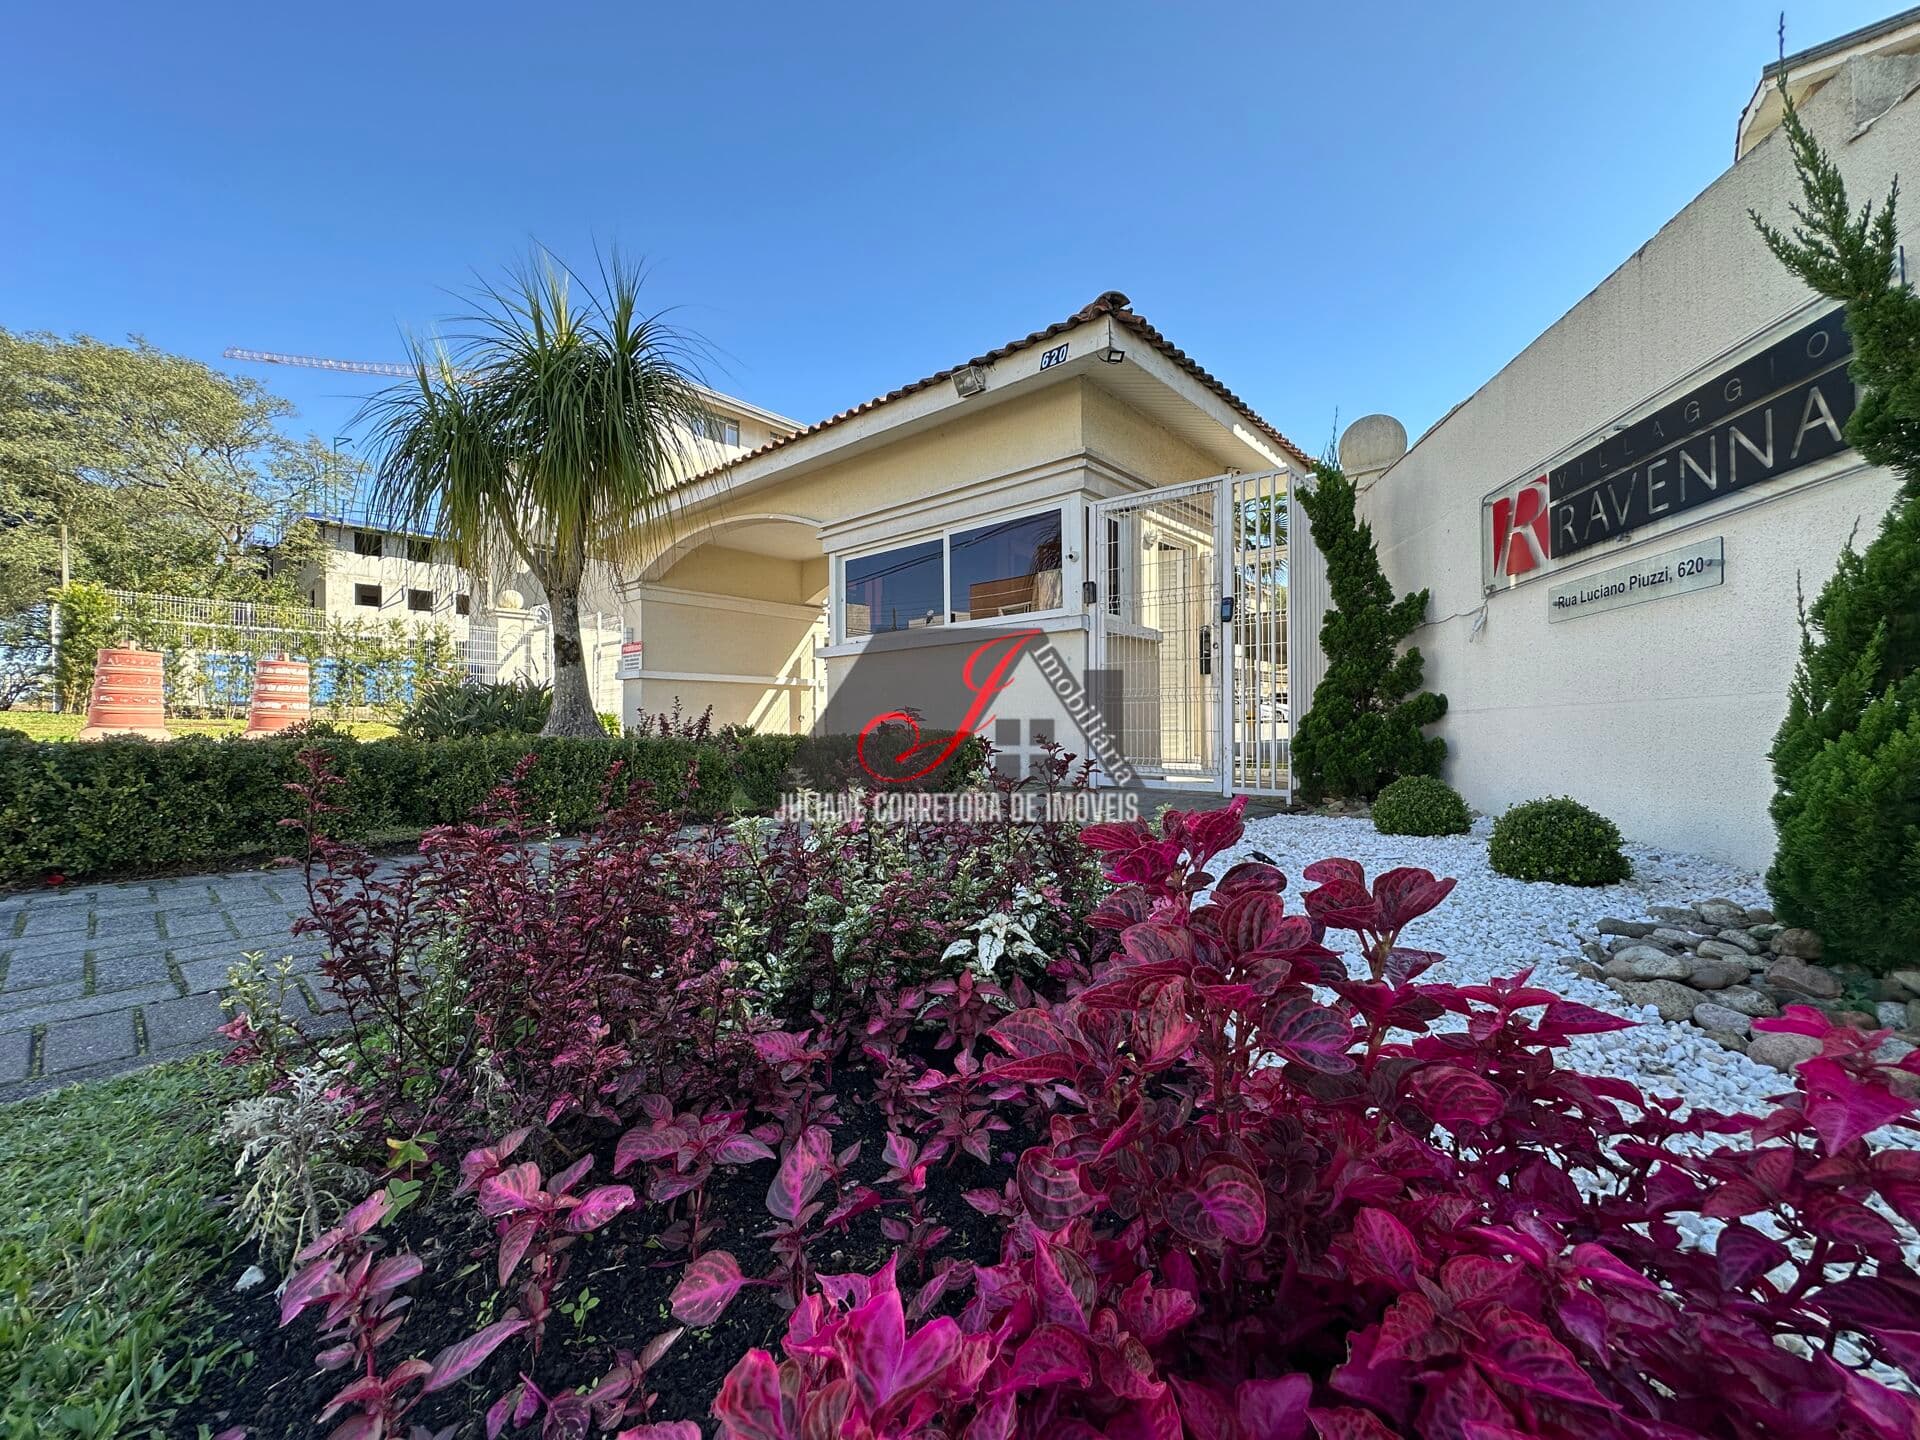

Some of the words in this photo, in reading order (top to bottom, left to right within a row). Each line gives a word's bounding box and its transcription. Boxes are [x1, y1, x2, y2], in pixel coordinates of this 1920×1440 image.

[1041, 345, 1067, 369] 620
[1556, 330, 1829, 489] VILLAGGIO
[1558, 386, 1843, 546] RAVENNA
[1557, 596, 1577, 609] Rua
[1580, 581, 1625, 603] Luciano
[1629, 566, 1673, 590] Piuzzi,
[1677, 556, 1704, 578] 620
